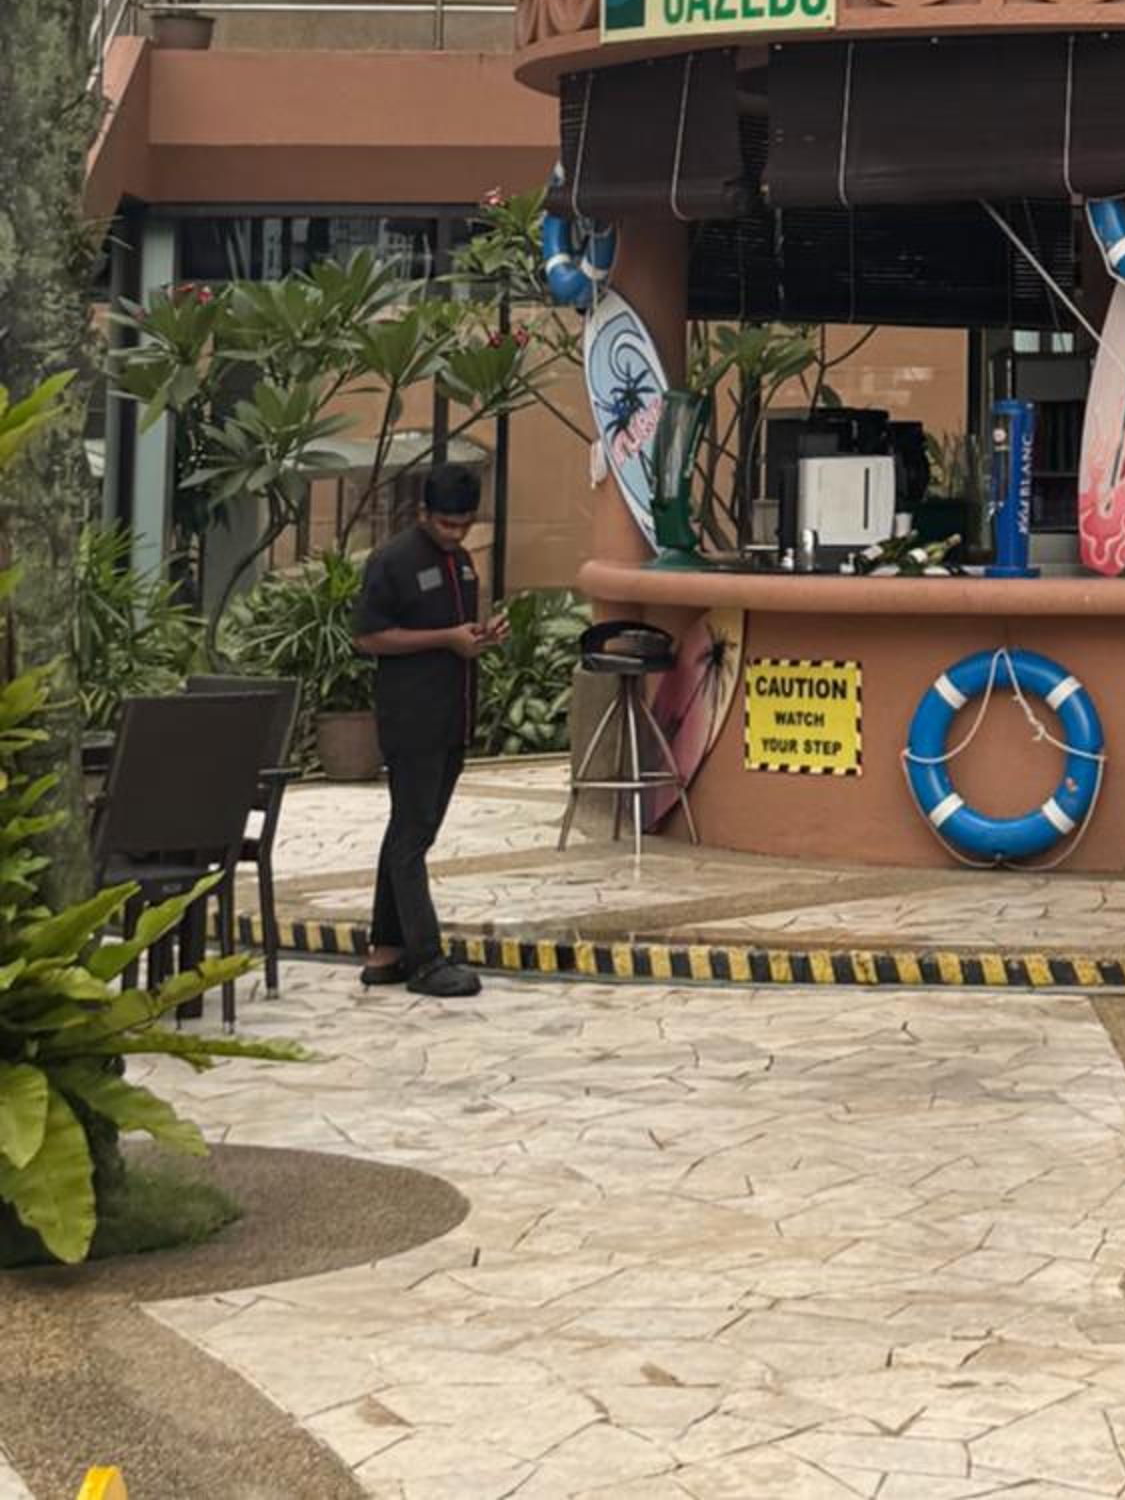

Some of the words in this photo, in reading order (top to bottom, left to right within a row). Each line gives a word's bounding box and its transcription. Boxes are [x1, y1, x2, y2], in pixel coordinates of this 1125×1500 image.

[755, 675, 848, 700] CAUTION
[774, 711, 826, 728] WATCH
[761, 737, 799, 755] YOUR
[803, 739, 843, 756] STEP
